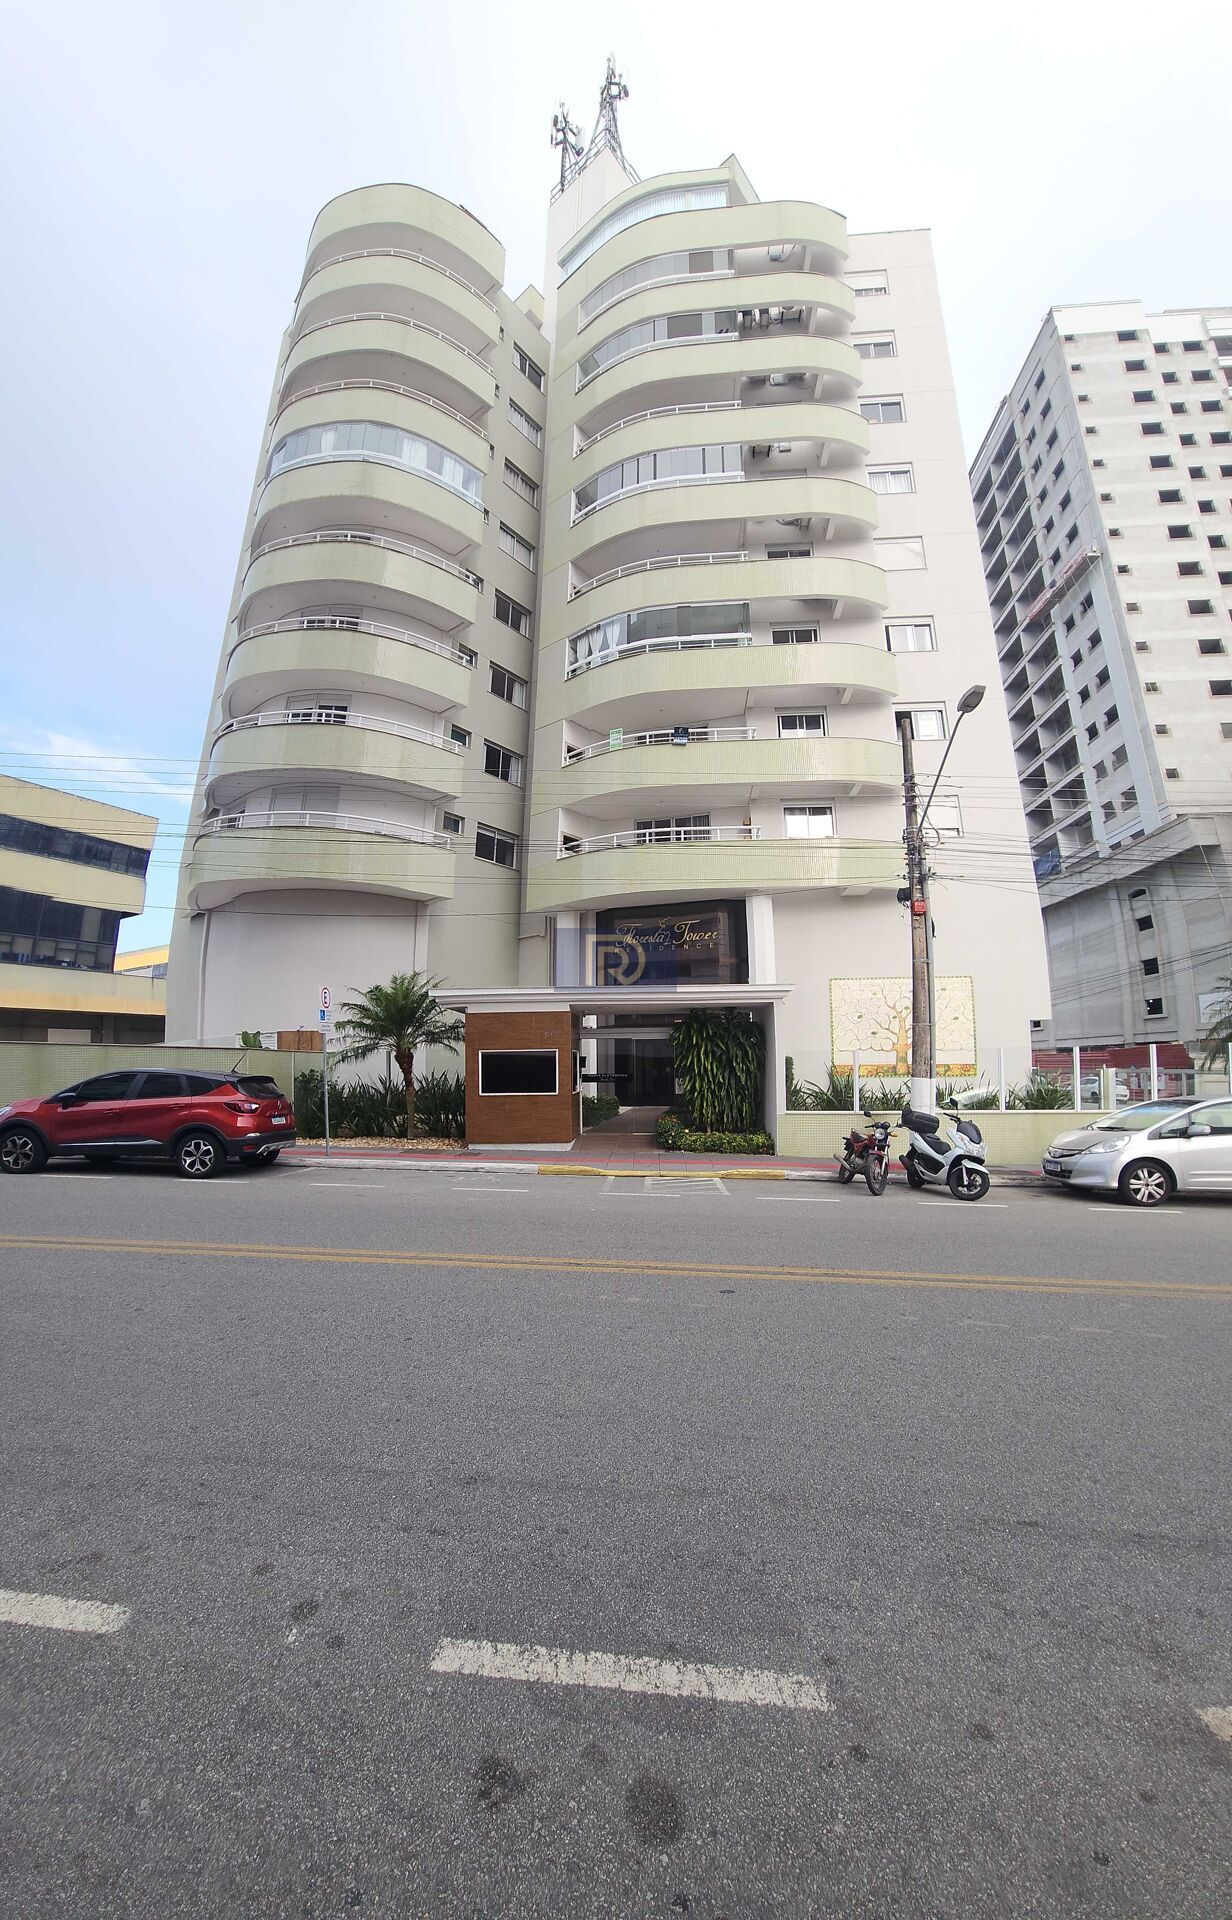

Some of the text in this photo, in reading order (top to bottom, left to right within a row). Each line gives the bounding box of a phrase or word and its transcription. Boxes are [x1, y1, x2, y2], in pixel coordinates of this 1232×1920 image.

[615, 919, 719, 947] Floresta Tower
[614, 942, 715, 954] RESIDENCE
